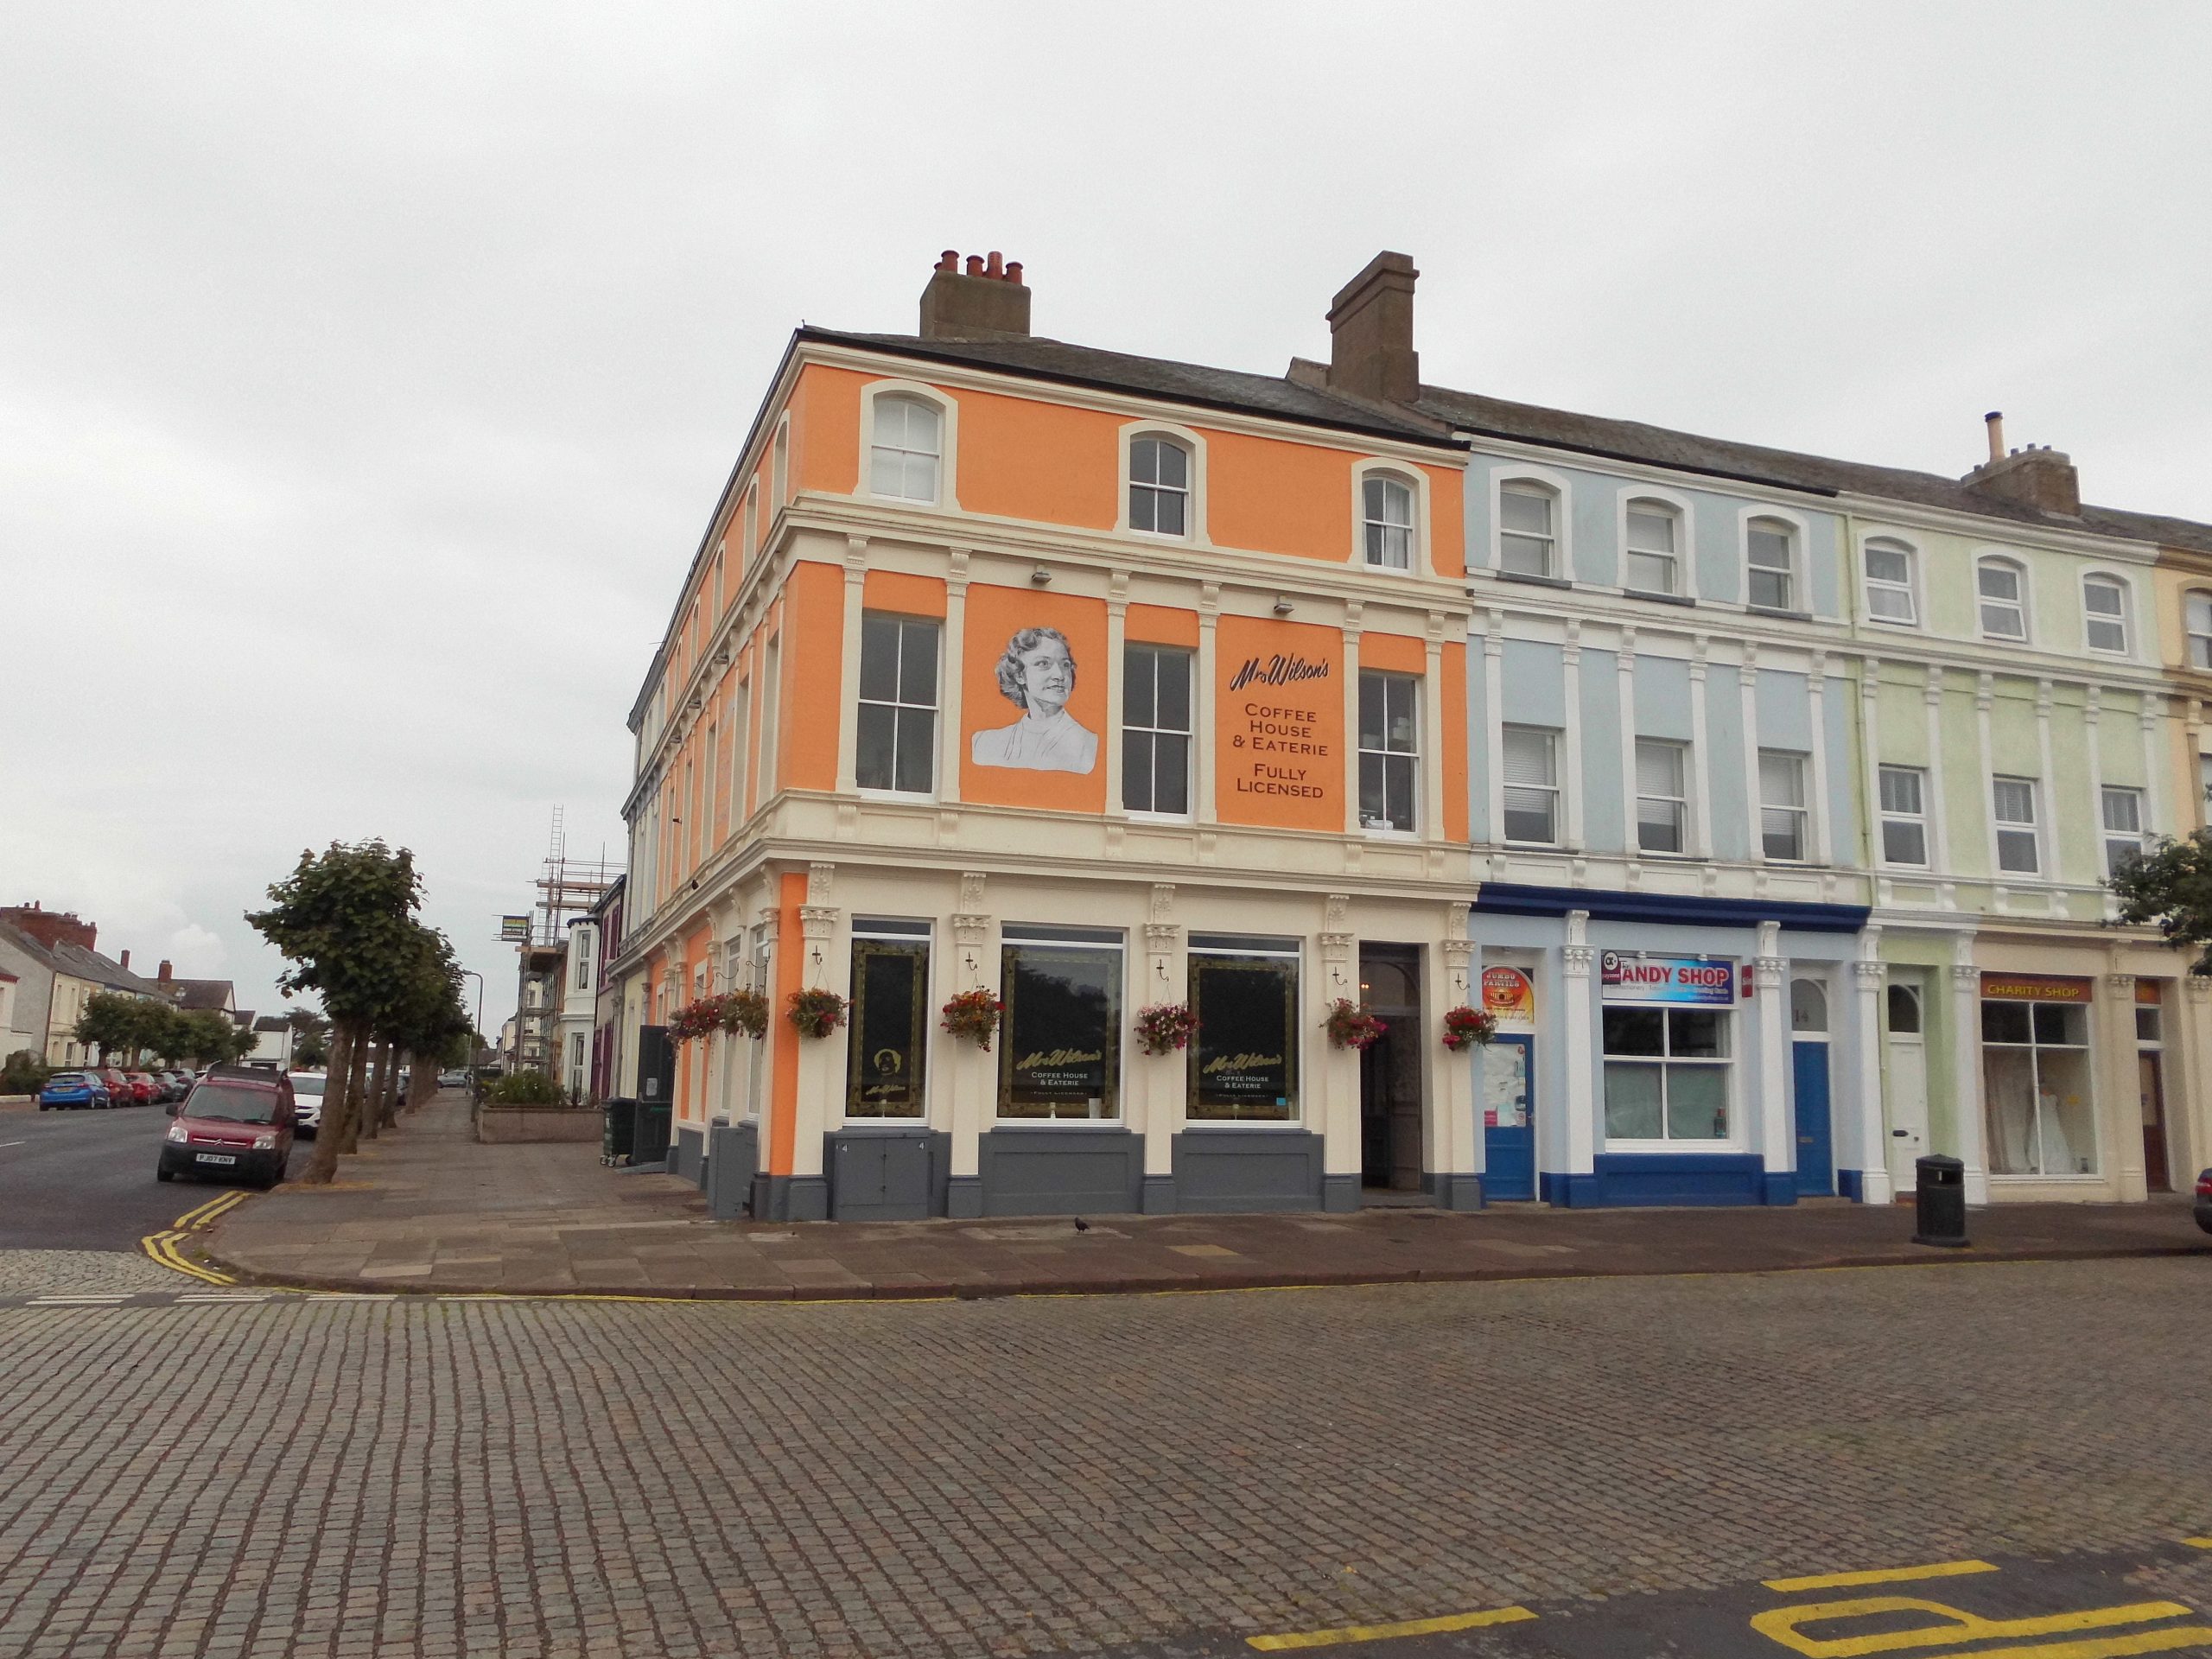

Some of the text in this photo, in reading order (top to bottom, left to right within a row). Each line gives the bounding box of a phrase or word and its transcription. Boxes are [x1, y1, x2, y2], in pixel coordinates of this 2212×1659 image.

[1230, 652, 1329, 691] Mrs Wilson's
[1245, 703, 1316, 722] COFFEE
[1250, 721, 1312, 738] HOUSE
[1233, 734, 1328, 756] & EATERIE
[1255, 763, 1306, 780] FULLY
[1237, 779, 1323, 798] LICENSED
[1622, 965, 1672, 983] ANDY
[1678, 967, 1729, 987] SHOP
[1988, 984, 2080, 997] CHARITY SHOP
